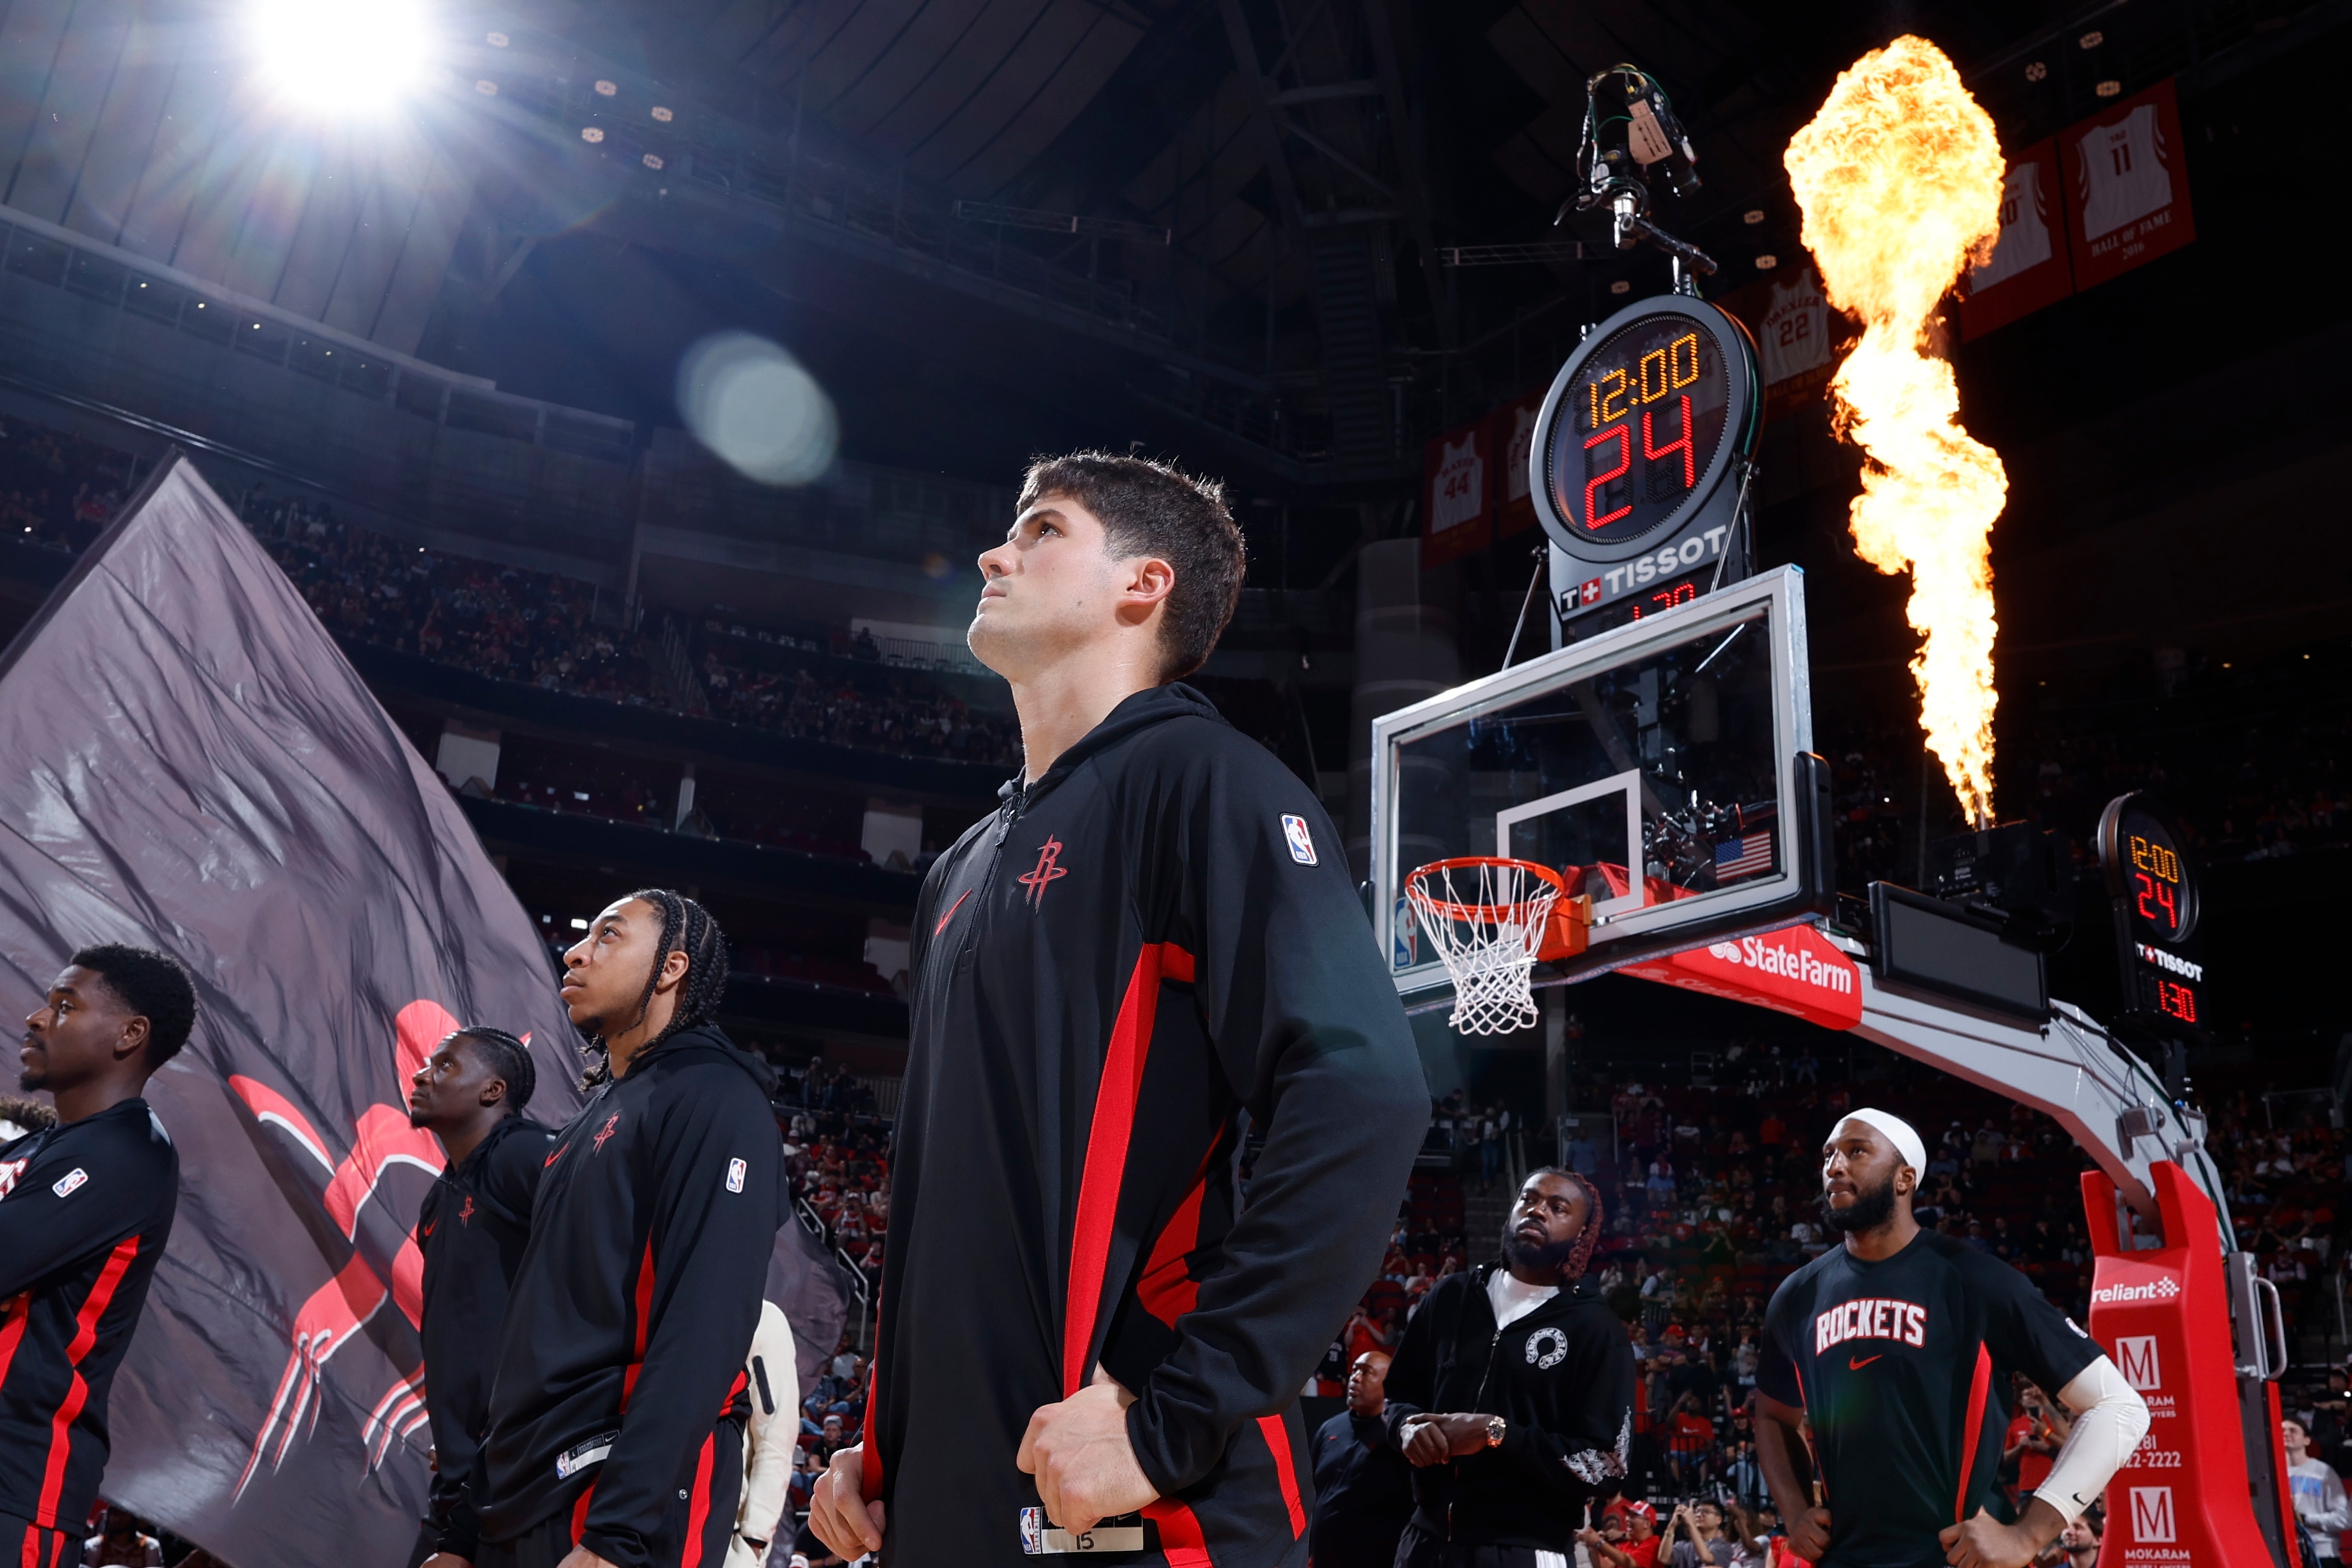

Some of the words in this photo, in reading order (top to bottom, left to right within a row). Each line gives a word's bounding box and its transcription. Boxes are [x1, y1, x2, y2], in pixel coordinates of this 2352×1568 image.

[2111, 143, 2131, 176] 11
[2091, 233, 2120, 258] HALL
[2122, 227, 2136, 243] OF
[2139, 209, 2172, 235] FAME
[1779, 312, 1809, 347] 22
[1590, 333, 1699, 428] 12:00
[1584, 394, 1694, 530] 24
[1444, 471, 1470, 500] 44
[1604, 524, 1727, 595] TISSOT
[2130, 835, 2179, 883] 12:00
[2134, 872, 2177, 928] 24
[2155, 947, 2203, 982] TISSOT
[2158, 979, 2197, 1023] 1:30
[2092, 1282, 2156, 1303] reliant
[1815, 1298, 1928, 1357] ROCKETS
[2137, 1434, 2157, 1451] 81
[1076, 1531, 1094, 1550] 15
[2124, 1548, 2191, 1560] MOKARAM
